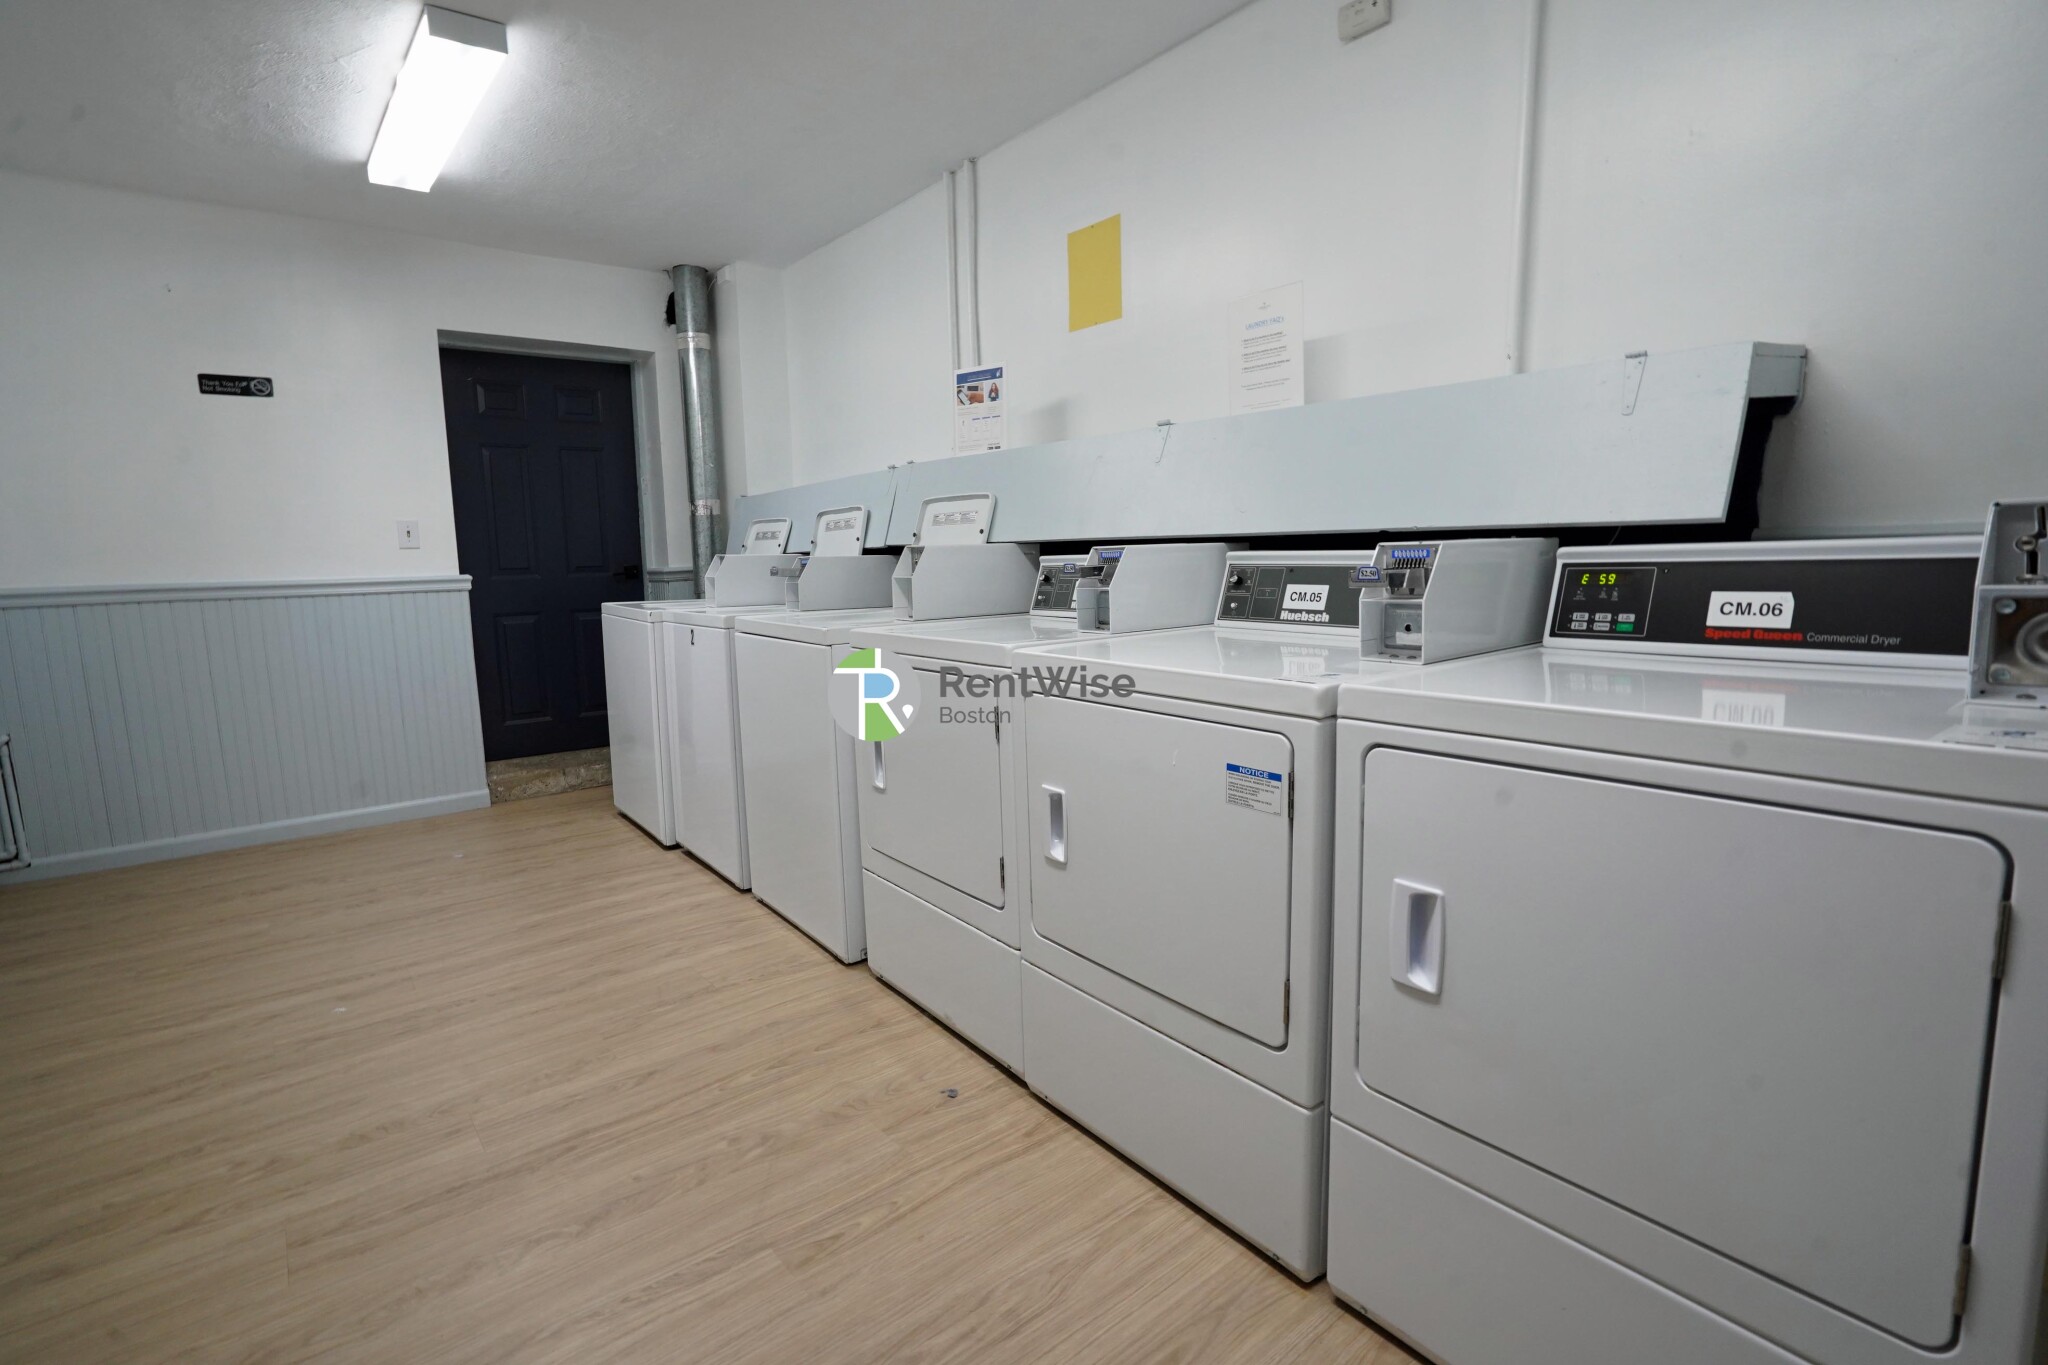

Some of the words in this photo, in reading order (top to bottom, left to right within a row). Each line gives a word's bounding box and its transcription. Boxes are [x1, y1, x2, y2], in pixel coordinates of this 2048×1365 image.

[1581, 573, 1590, 585] E
[1599, 573, 1617, 585] 59
[1290, 591, 1323, 603] CM.05
[1719, 601, 1784, 617] CM.06
[1280, 610, 1330, 622] Huebsch
[1704, 628, 1751, 640] Speed
[1753, 629, 1803, 641] Queen
[1806, 632, 1868, 644] Commercial
[1870, 634, 1901, 646] Dryer
[1239, 766, 1269, 778] NOTICE
